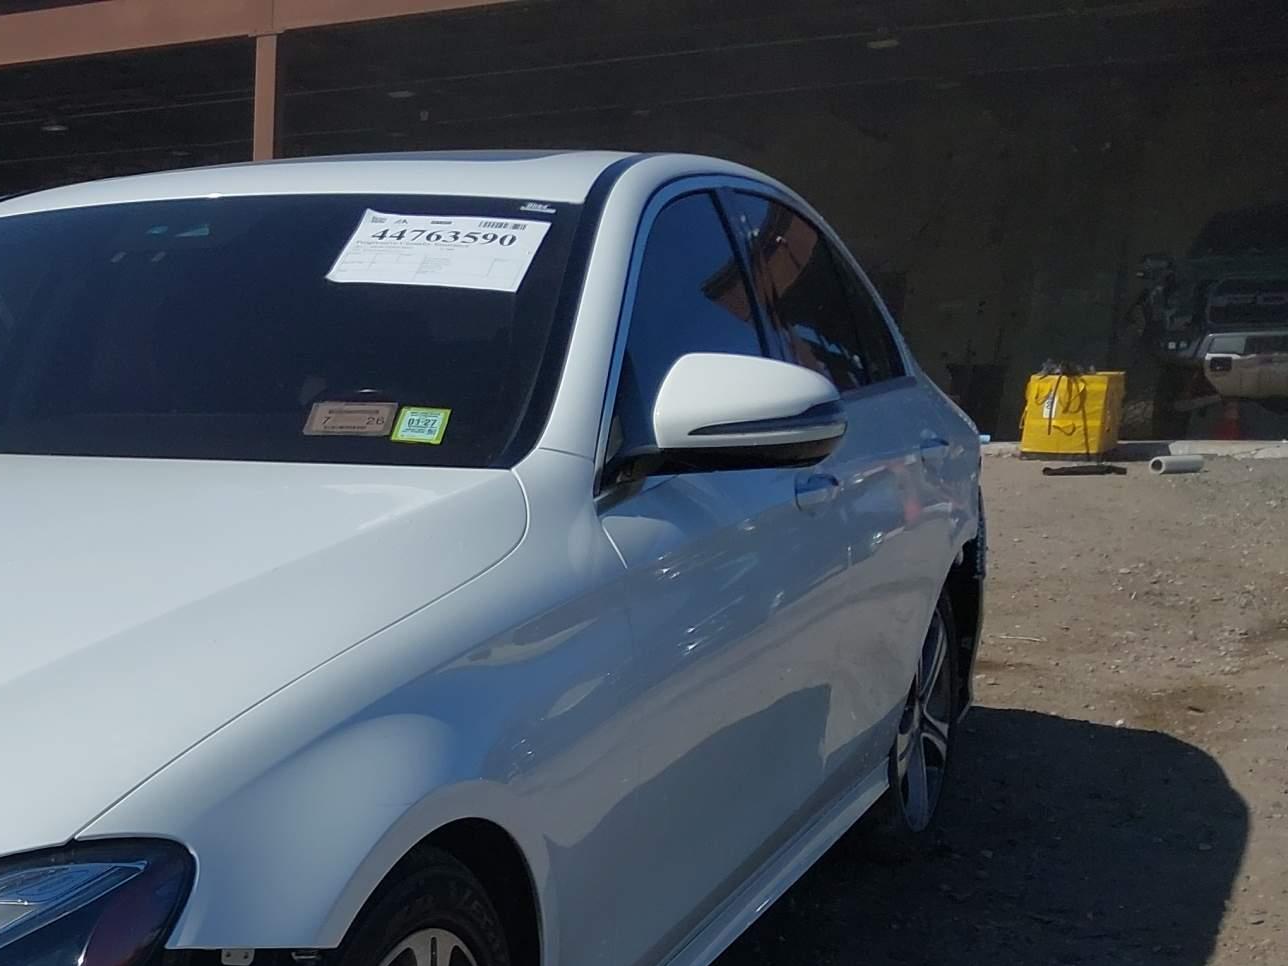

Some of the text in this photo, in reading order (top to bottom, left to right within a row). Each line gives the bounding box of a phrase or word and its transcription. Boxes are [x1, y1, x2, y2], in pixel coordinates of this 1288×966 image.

[370, 227, 518, 248] 44763590
[320, 416, 385, 425] 7 26
